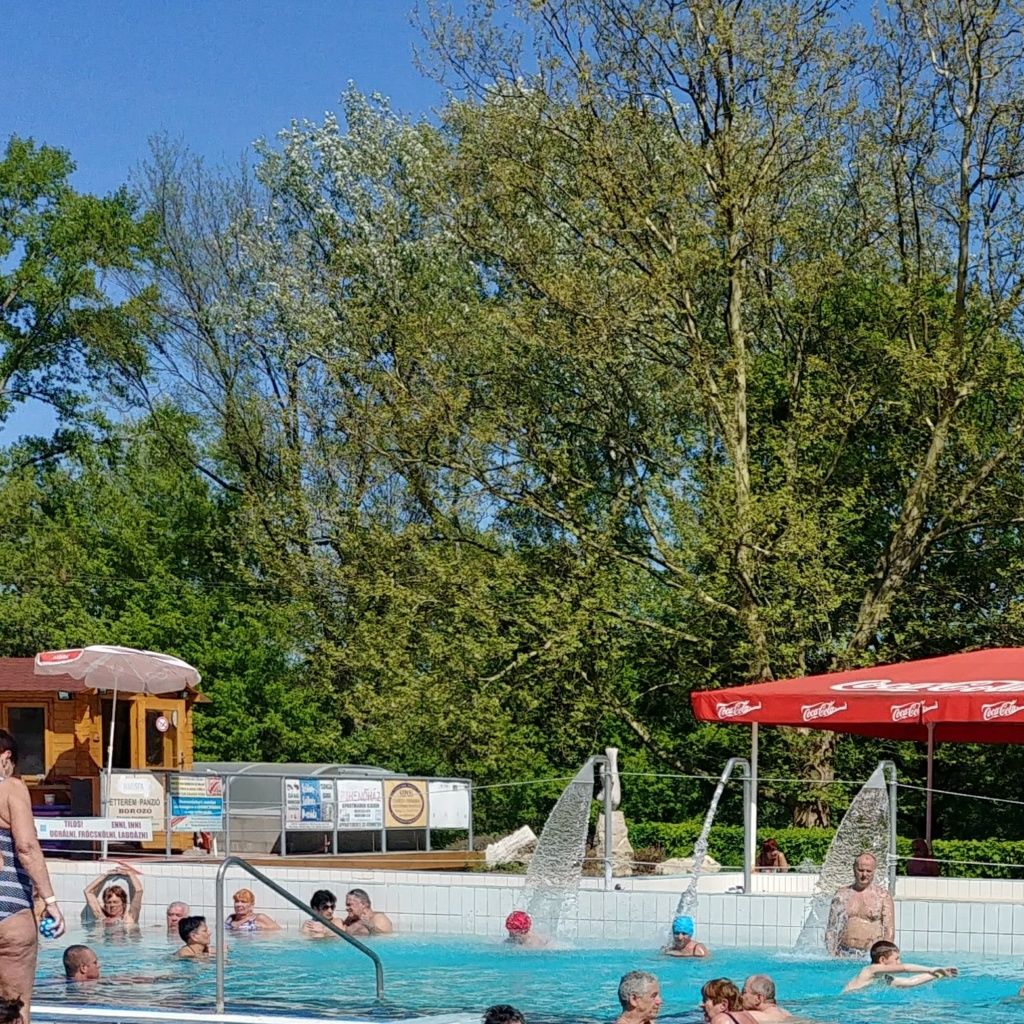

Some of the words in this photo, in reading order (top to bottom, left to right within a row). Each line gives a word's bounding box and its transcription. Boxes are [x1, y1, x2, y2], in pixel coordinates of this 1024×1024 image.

[715, 700, 761, 719] Coca-Cola
[801, 700, 847, 721] Coca-Cola
[890, 700, 938, 722] Coca-Cola
